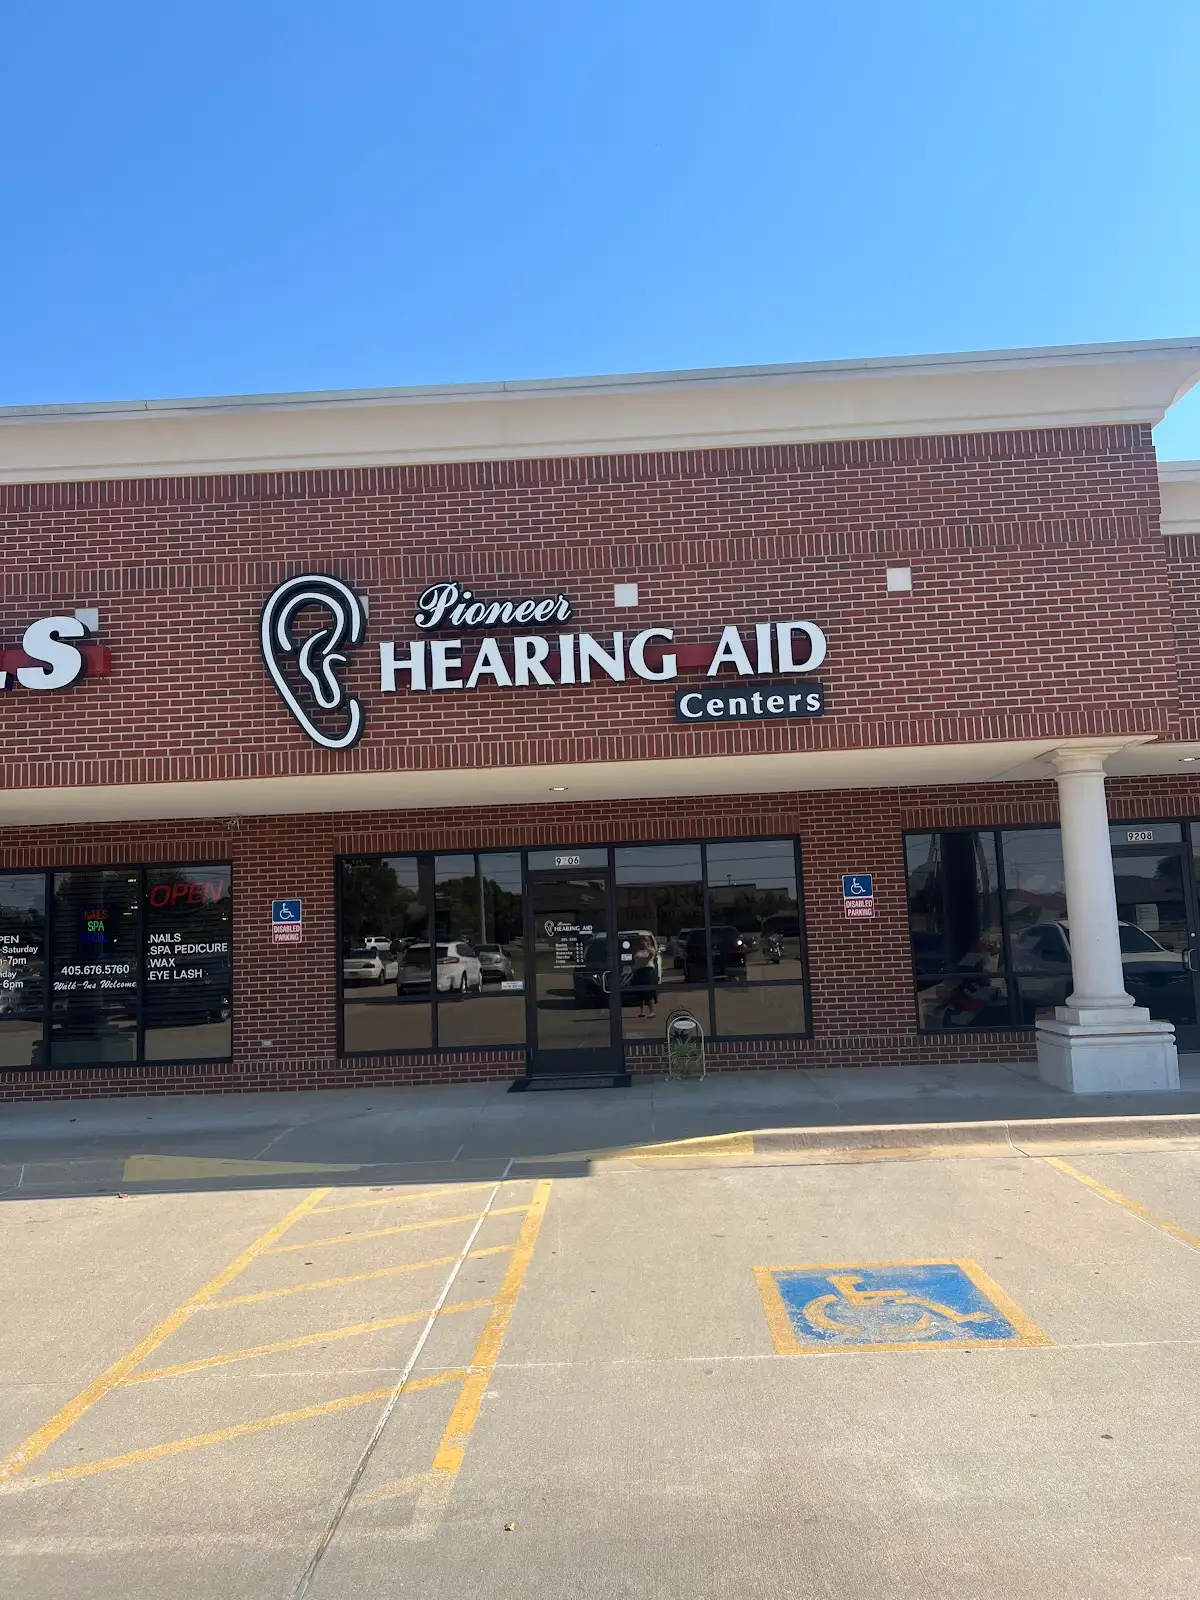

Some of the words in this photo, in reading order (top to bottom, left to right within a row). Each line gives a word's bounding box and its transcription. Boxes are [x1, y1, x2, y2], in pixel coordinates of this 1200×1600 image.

[414, 582, 572, 628] Pioneer
[0, 615, 85, 690] S
[379, 627, 677, 692] HEARING
[707, 620, 827, 677] AID
[679, 688, 821, 718] Centers
[1128, 832, 1152, 841] 9208
[150, 879, 224, 907] OPEN
[846, 900, 872, 908] DISABLED
[87, 920, 105, 932] SPA
[274, 933, 298, 941] PARKING
[174, 942, 229, 954] PEDICURE
[61, 964, 130, 976] 405.676.5760
[174, 968, 203, 979] LASH
[52, 981, 97, 991] Walk-Ins
[99, 980, 137, 989] Welcome
